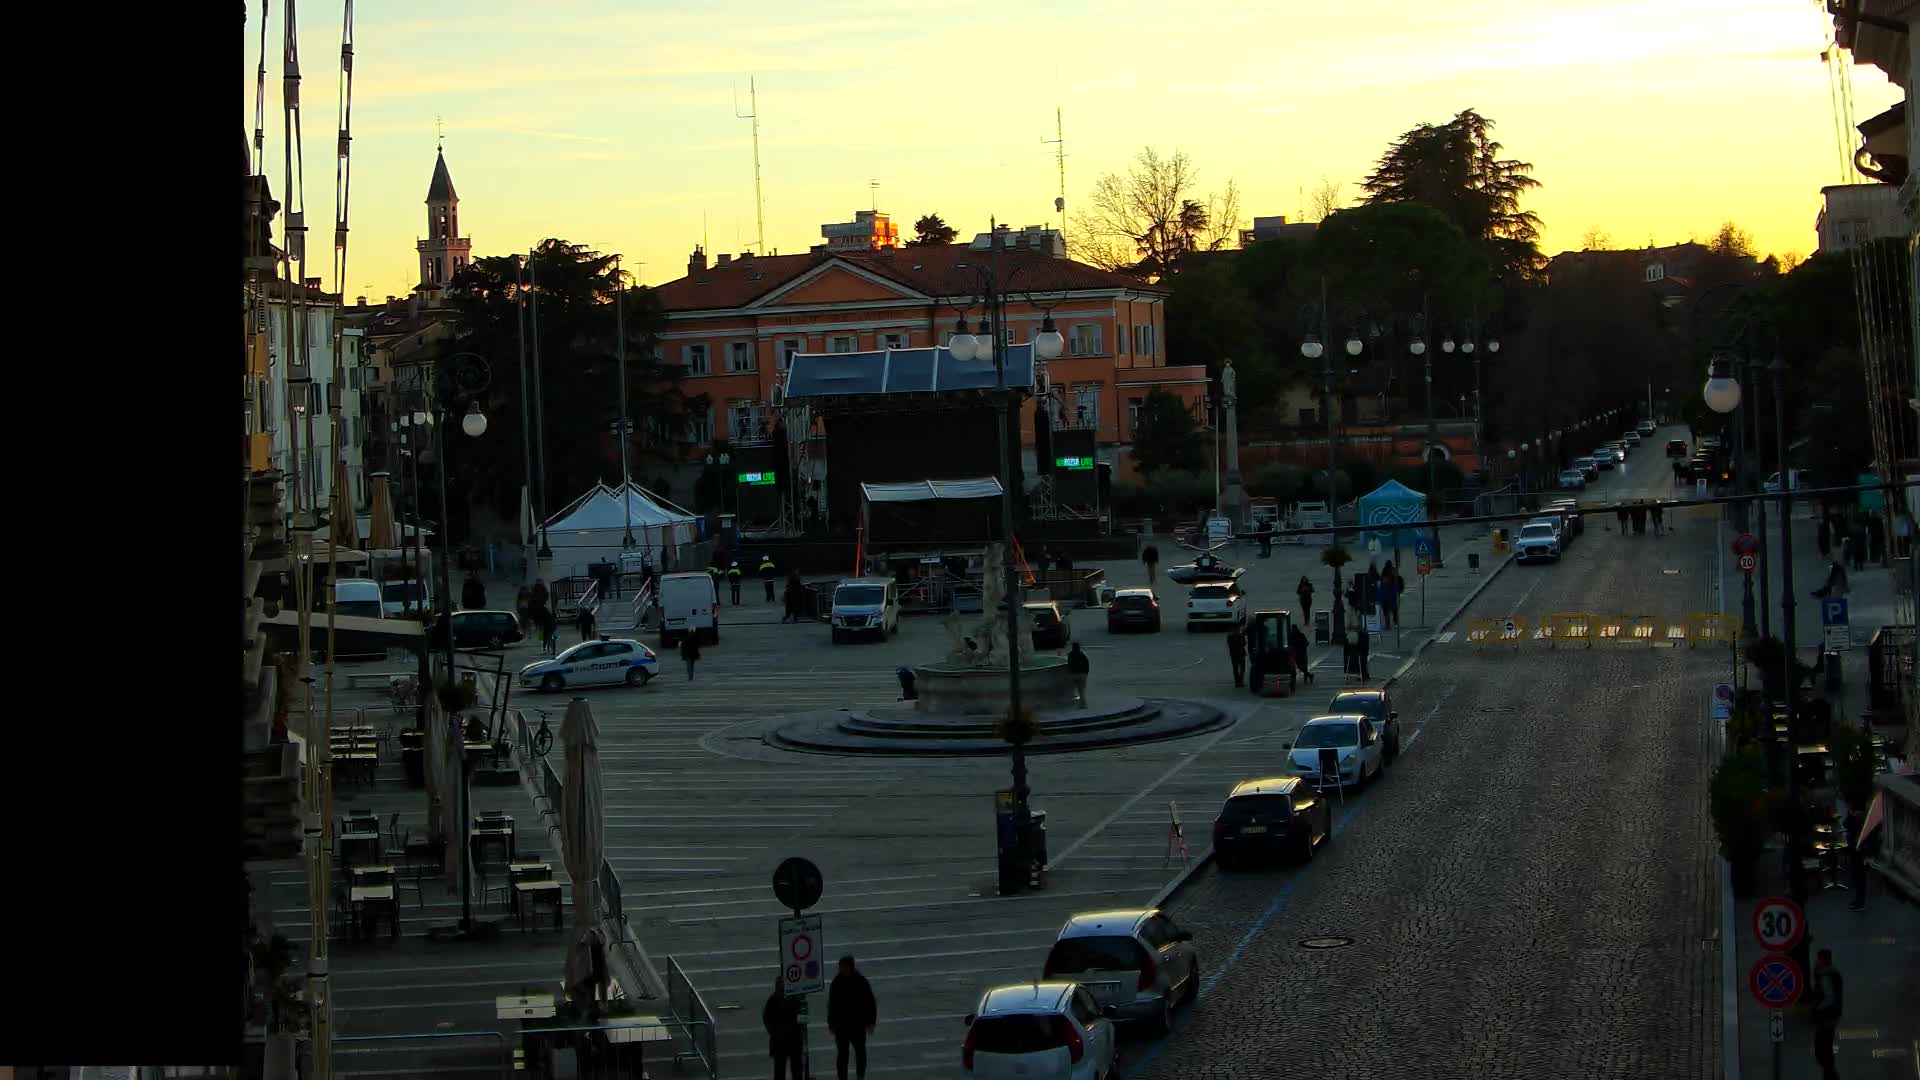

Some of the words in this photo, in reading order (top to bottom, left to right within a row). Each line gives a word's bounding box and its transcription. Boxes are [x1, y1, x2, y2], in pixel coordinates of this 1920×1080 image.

[1743, 558, 1752, 566] 20
[1827, 603, 1842, 621] P
[1763, 912, 1791, 937] 30
